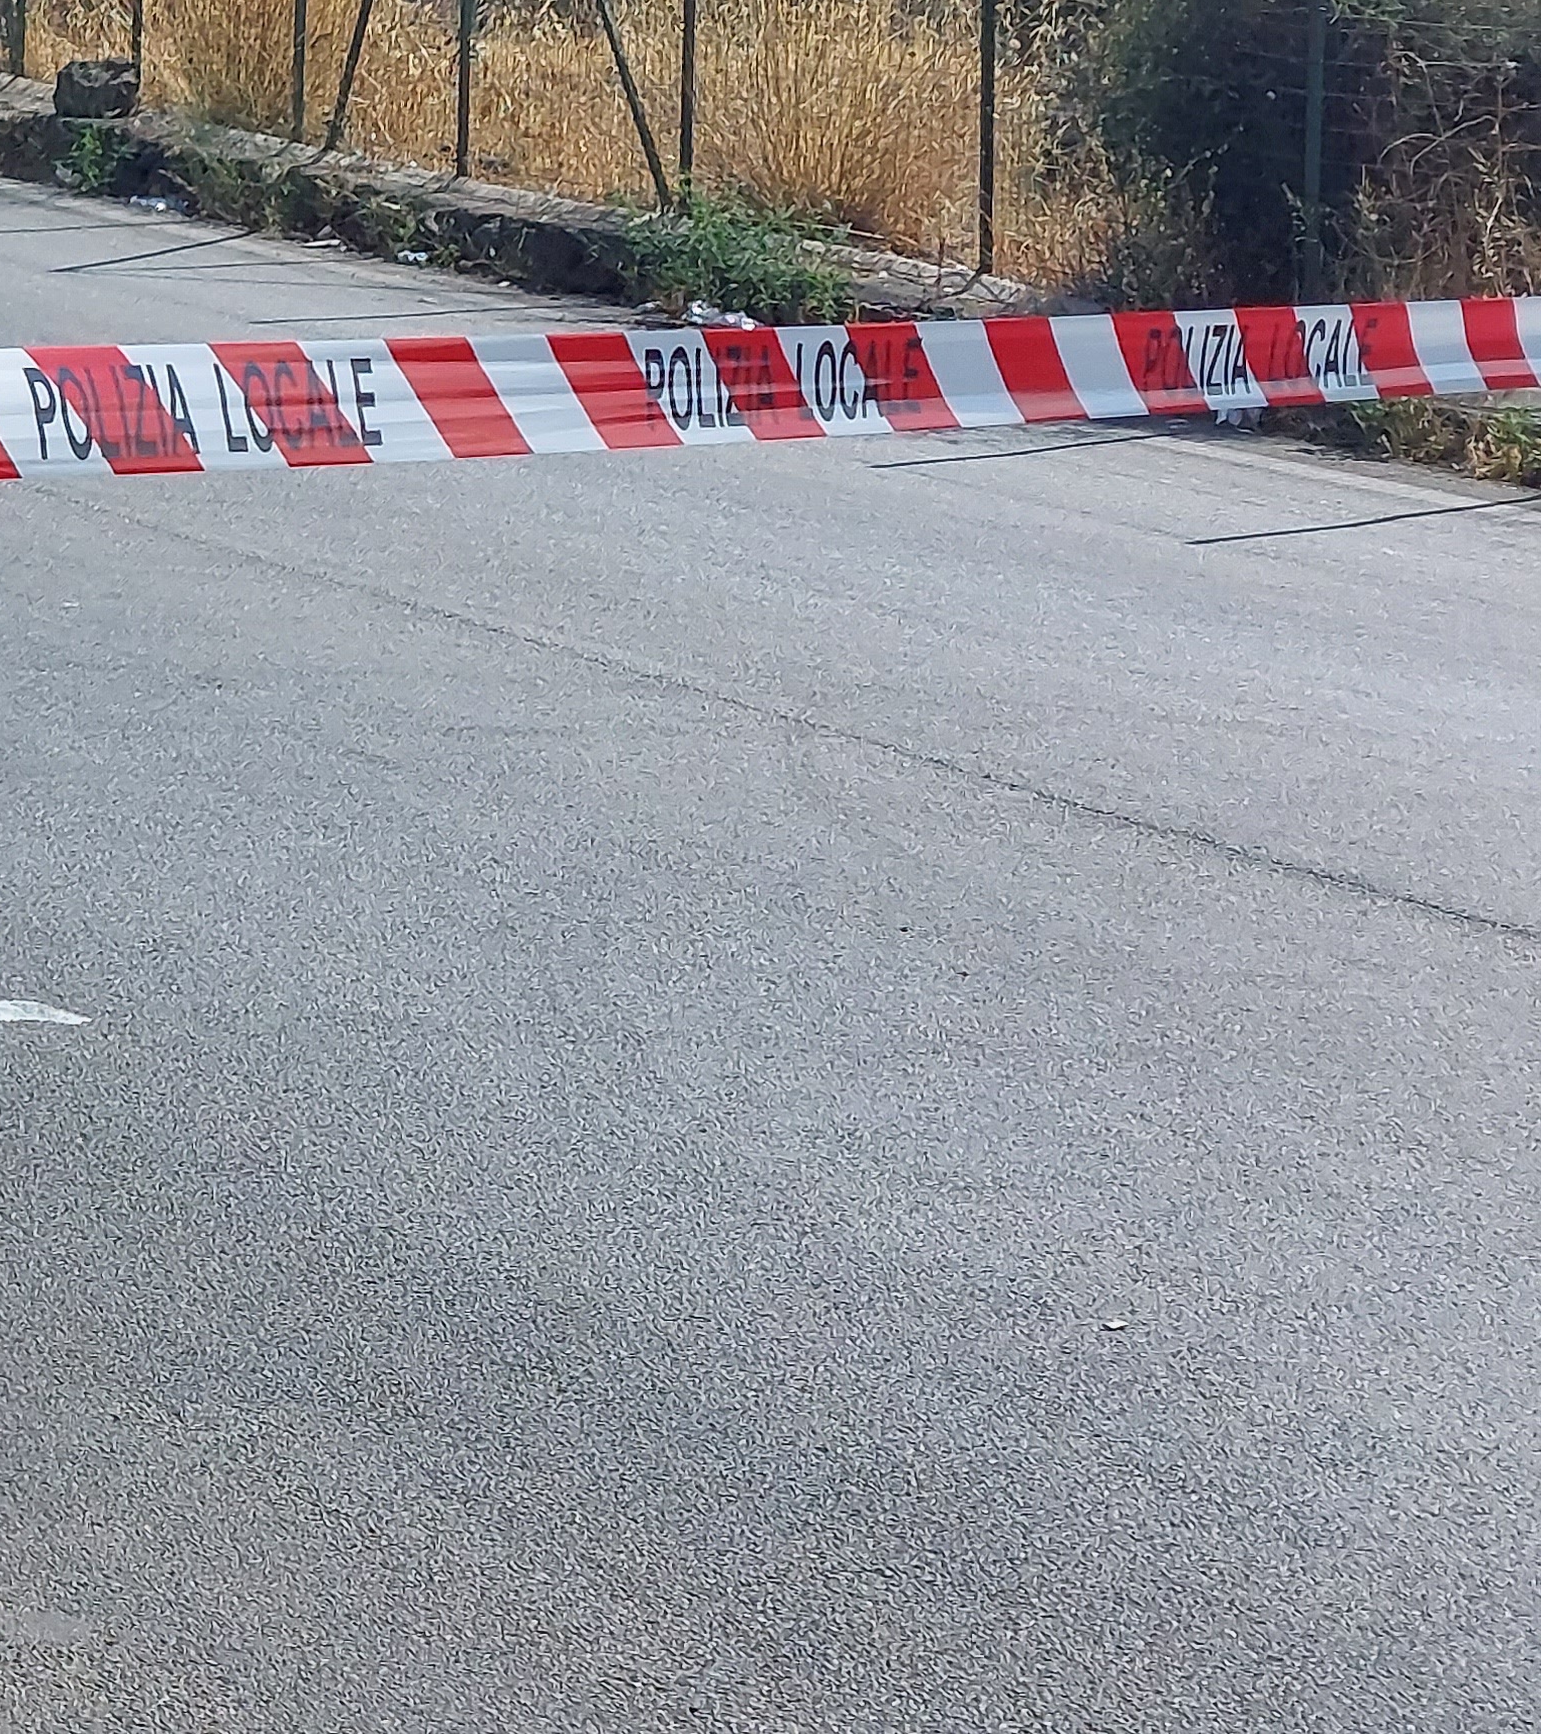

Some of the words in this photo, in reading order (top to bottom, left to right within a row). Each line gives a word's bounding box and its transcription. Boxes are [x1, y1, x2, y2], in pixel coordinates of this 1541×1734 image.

[644, 343, 781, 432] POLIZIA
[796, 336, 923, 422] LOCALE
[1142, 319, 1251, 397] POLIZIA
[1268, 316, 1378, 388] LOCALE
[23, 362, 201, 461] POLIZIA
[213, 357, 383, 454] LOCALE
